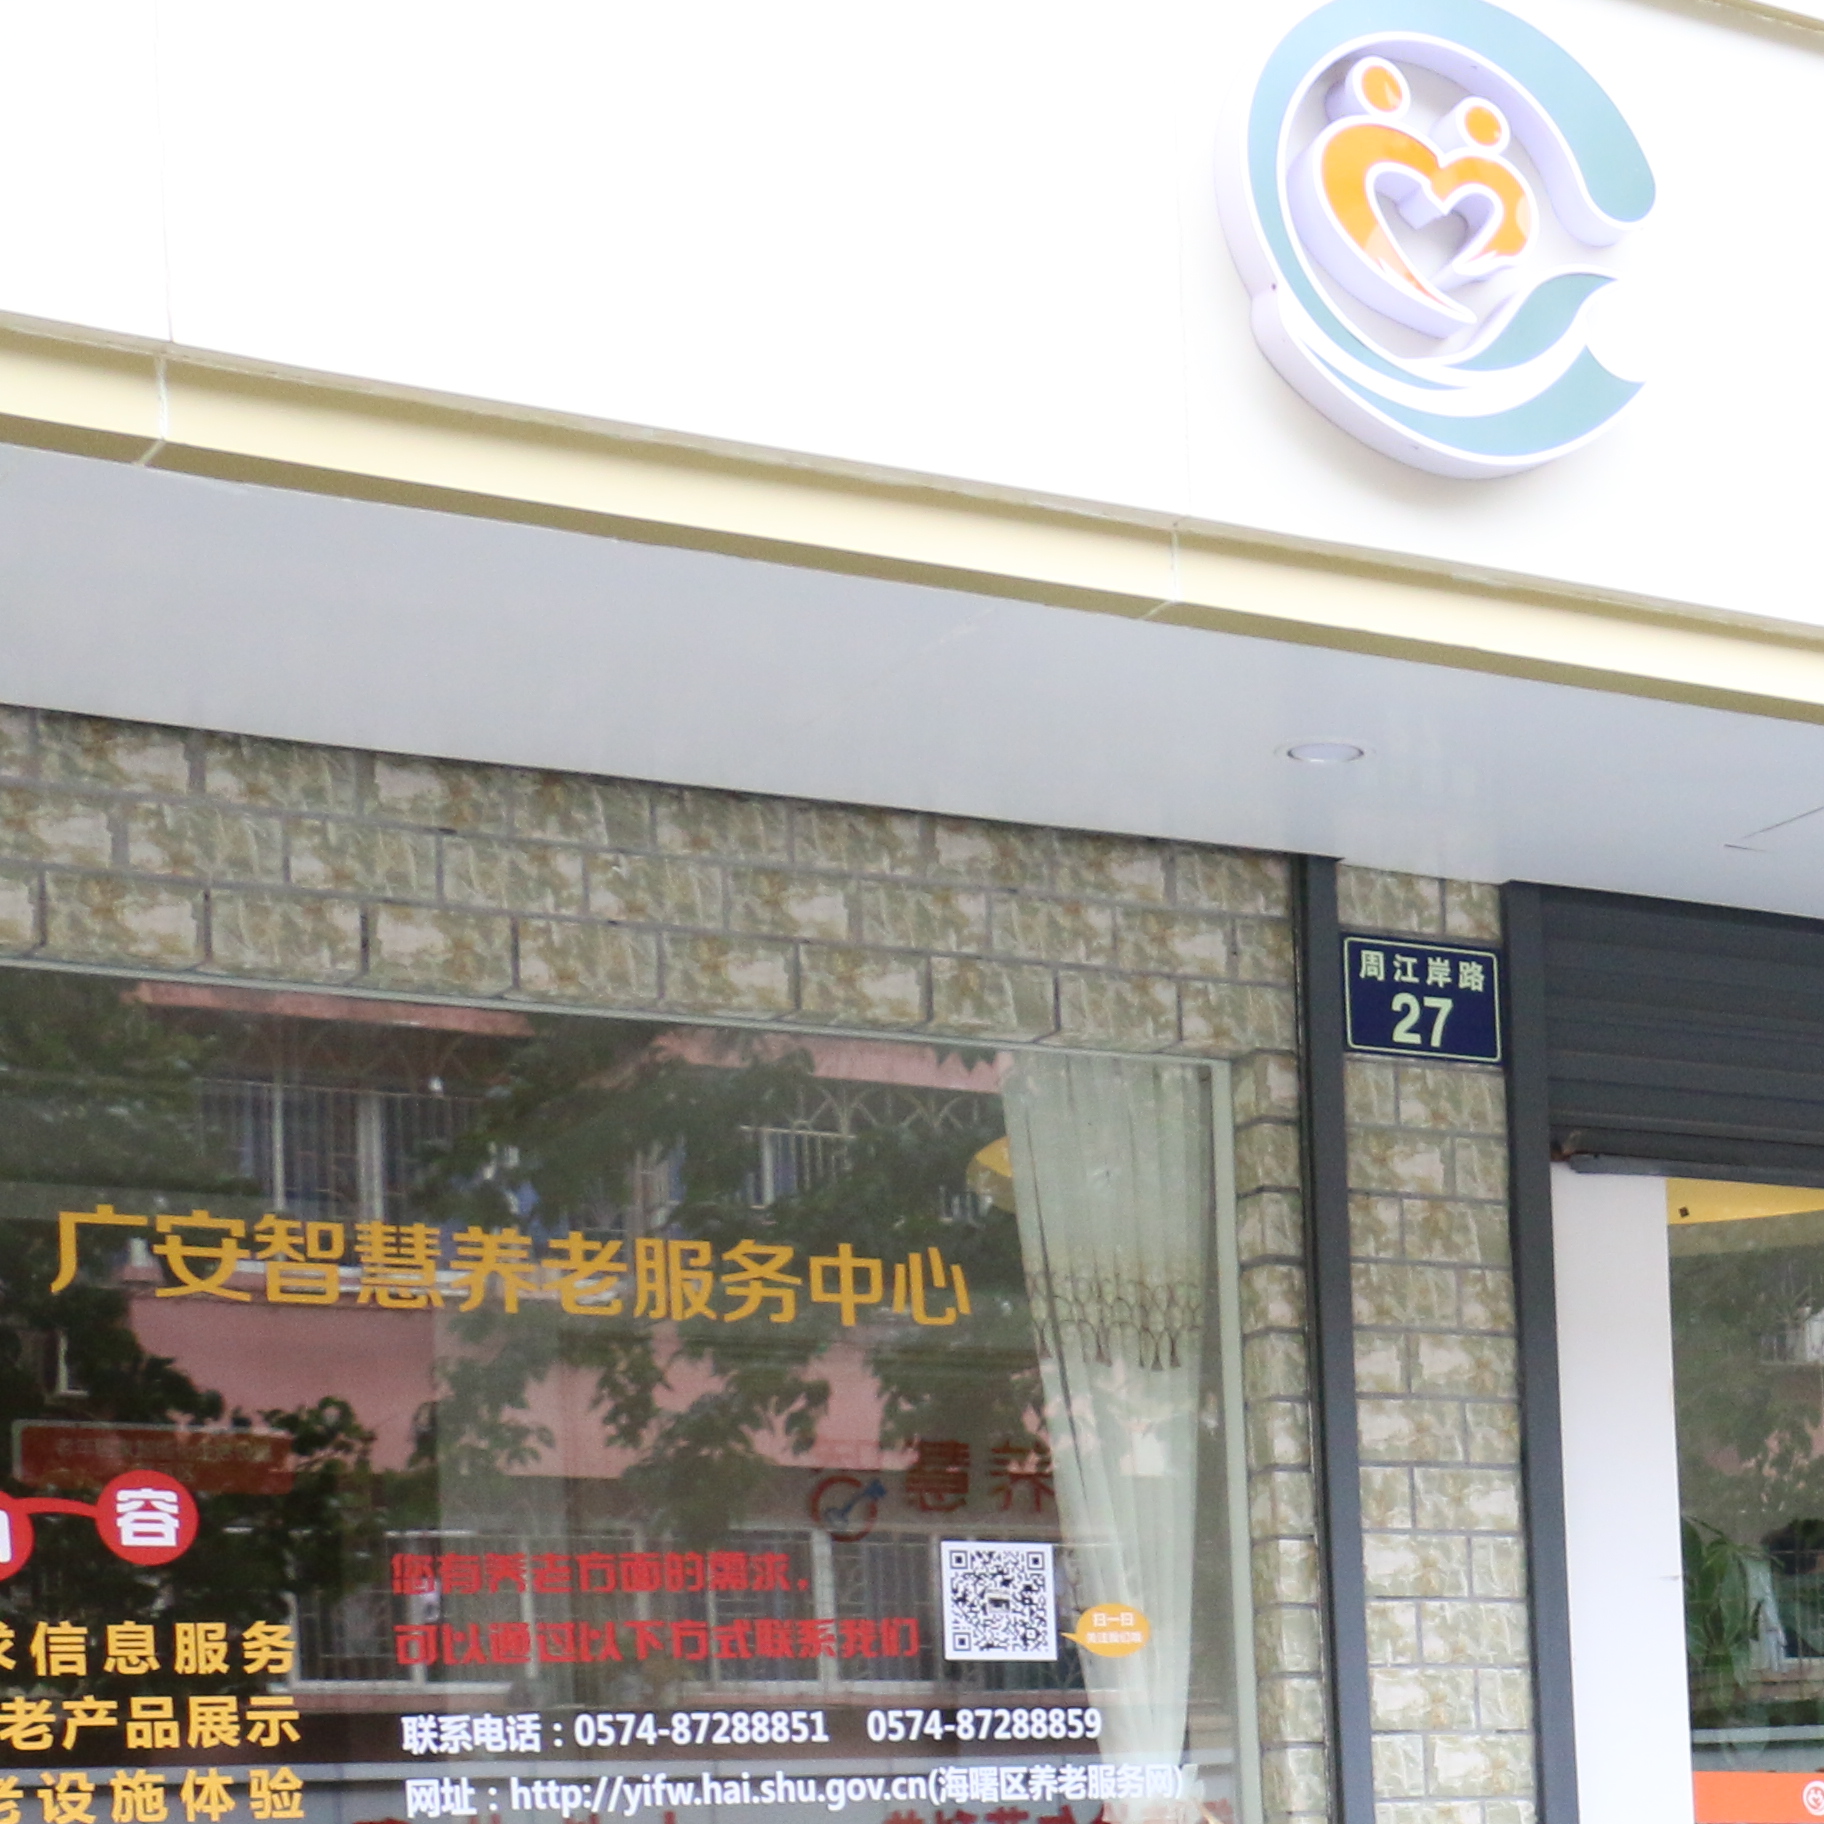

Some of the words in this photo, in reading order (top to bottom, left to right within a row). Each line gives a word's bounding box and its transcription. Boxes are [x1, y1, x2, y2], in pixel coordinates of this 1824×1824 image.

[1359, 949, 1486, 993] 周江岸路
[1391, 992, 1454, 1048] 27
[50, 1204, 973, 1326] 广安智慧养老服务中心
[393, 1615, 921, 1666] 可以通过以下方式联系我们
[866, 1707, 1103, 1743] 0574-87288859
